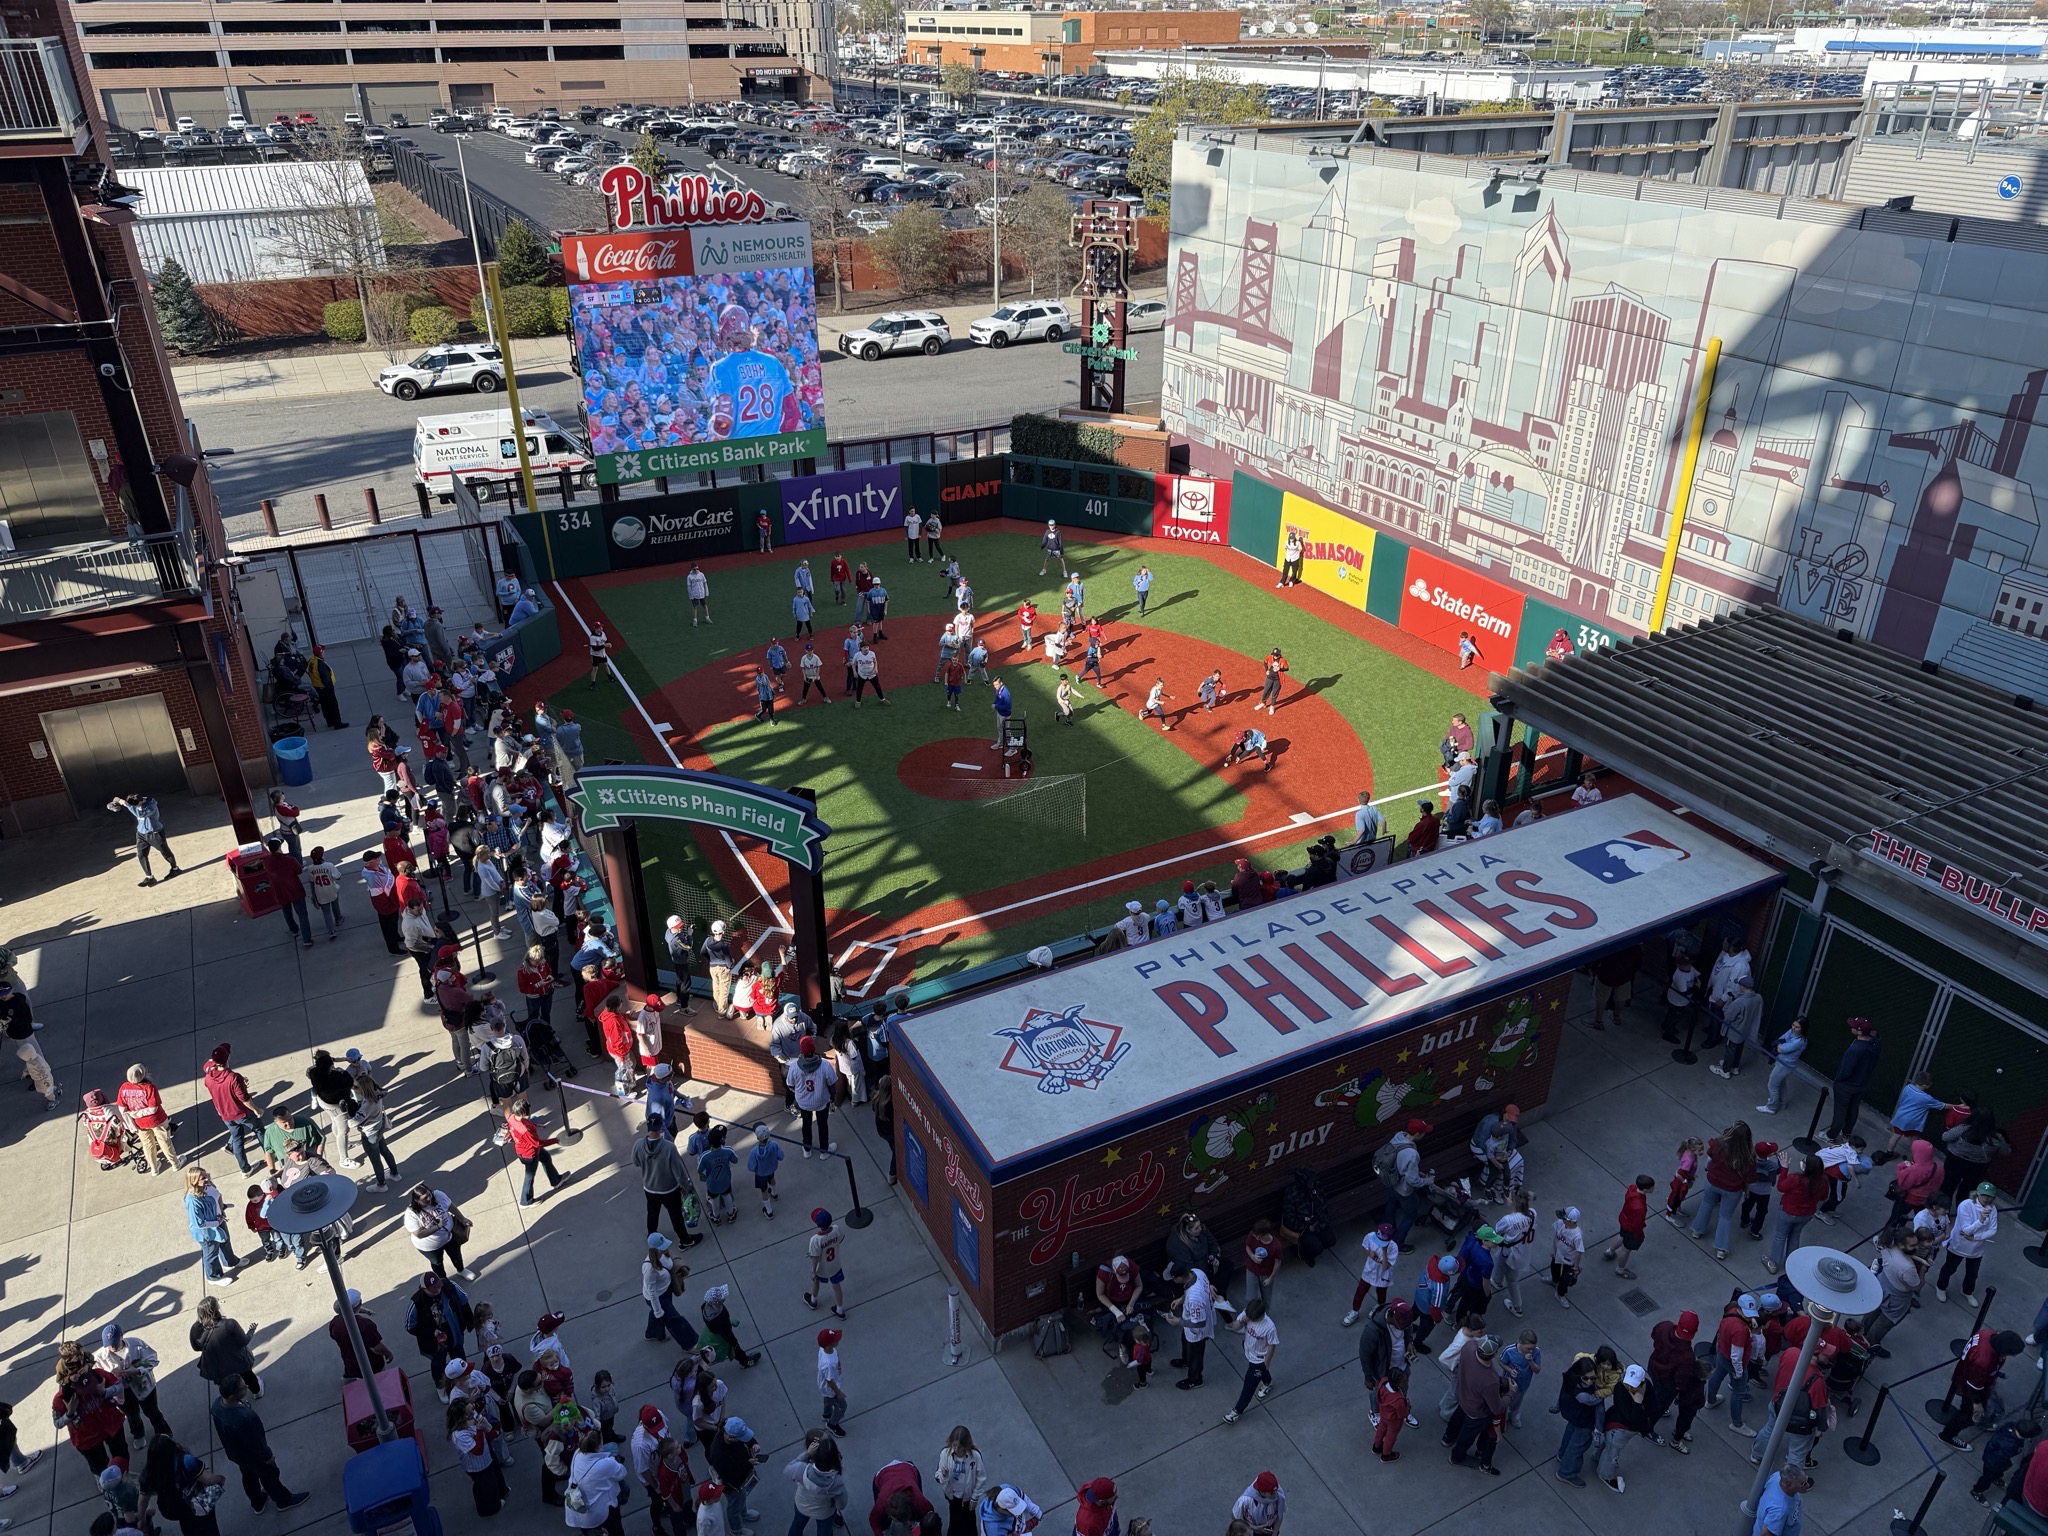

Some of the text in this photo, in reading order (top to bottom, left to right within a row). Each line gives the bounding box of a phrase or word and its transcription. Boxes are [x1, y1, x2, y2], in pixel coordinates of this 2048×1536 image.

[2002, 181, 2017, 193] BAC
[600, 165, 766, 230] Phillies
[732, 236, 806, 252] NEMOURS
[594, 240, 680, 275] Coca-Cola
[733, 250, 806, 264] CHILDREN'S HEALTH
[1062, 342, 1138, 361] Citizens Bank
[739, 363, 766, 380] BOHM
[1087, 357, 1114, 372] Park
[739, 383, 775, 424] 28
[436, 445, 488, 457] NATIONAL
[459, 453, 489, 461] SERVICES
[647, 438, 806, 472] Citizens Bank Park
[941, 480, 1001, 502] GIANT
[787, 482, 898, 530] xfinity
[1085, 499, 1109, 517] 401
[558, 511, 592, 532] 334
[648, 508, 734, 534] NovaCare
[650, 526, 732, 544] REHABILITATION
[1162, 525, 1220, 543] TOYOTA
[496, 645, 514, 662] MLB
[617, 788, 786, 833] Citizens Phan Field
[1870, 829, 1931, 879] THE
[1191, 902, 1198, 913] 3
[1214, 901, 1221, 912] 3
[1134, 854, 1506, 979] PHILADELPHIA
[1137, 926, 1144, 936] 3
[1165, 921, 1176, 934] 12
[1152, 869, 1598, 1058] PHILLIES
[1036, 1031, 1087, 1057] NATIONAL
[1418, 1015, 1479, 1056] ball
[806, 1080, 815, 1092] 3
[897, 1078, 922, 1121] WELCOME
[923, 1115, 931, 1133] TO
[932, 1129, 943, 1151] THE
[943, 1137, 984, 1222] Yard
[1264, 1122, 1335, 1167] play
[713, 1165, 722, 1180] 7
[1010, 1226, 1030, 1242] THE
[1020, 1151, 1165, 1265] Yard
[825, 1247, 835, 1262] 3
